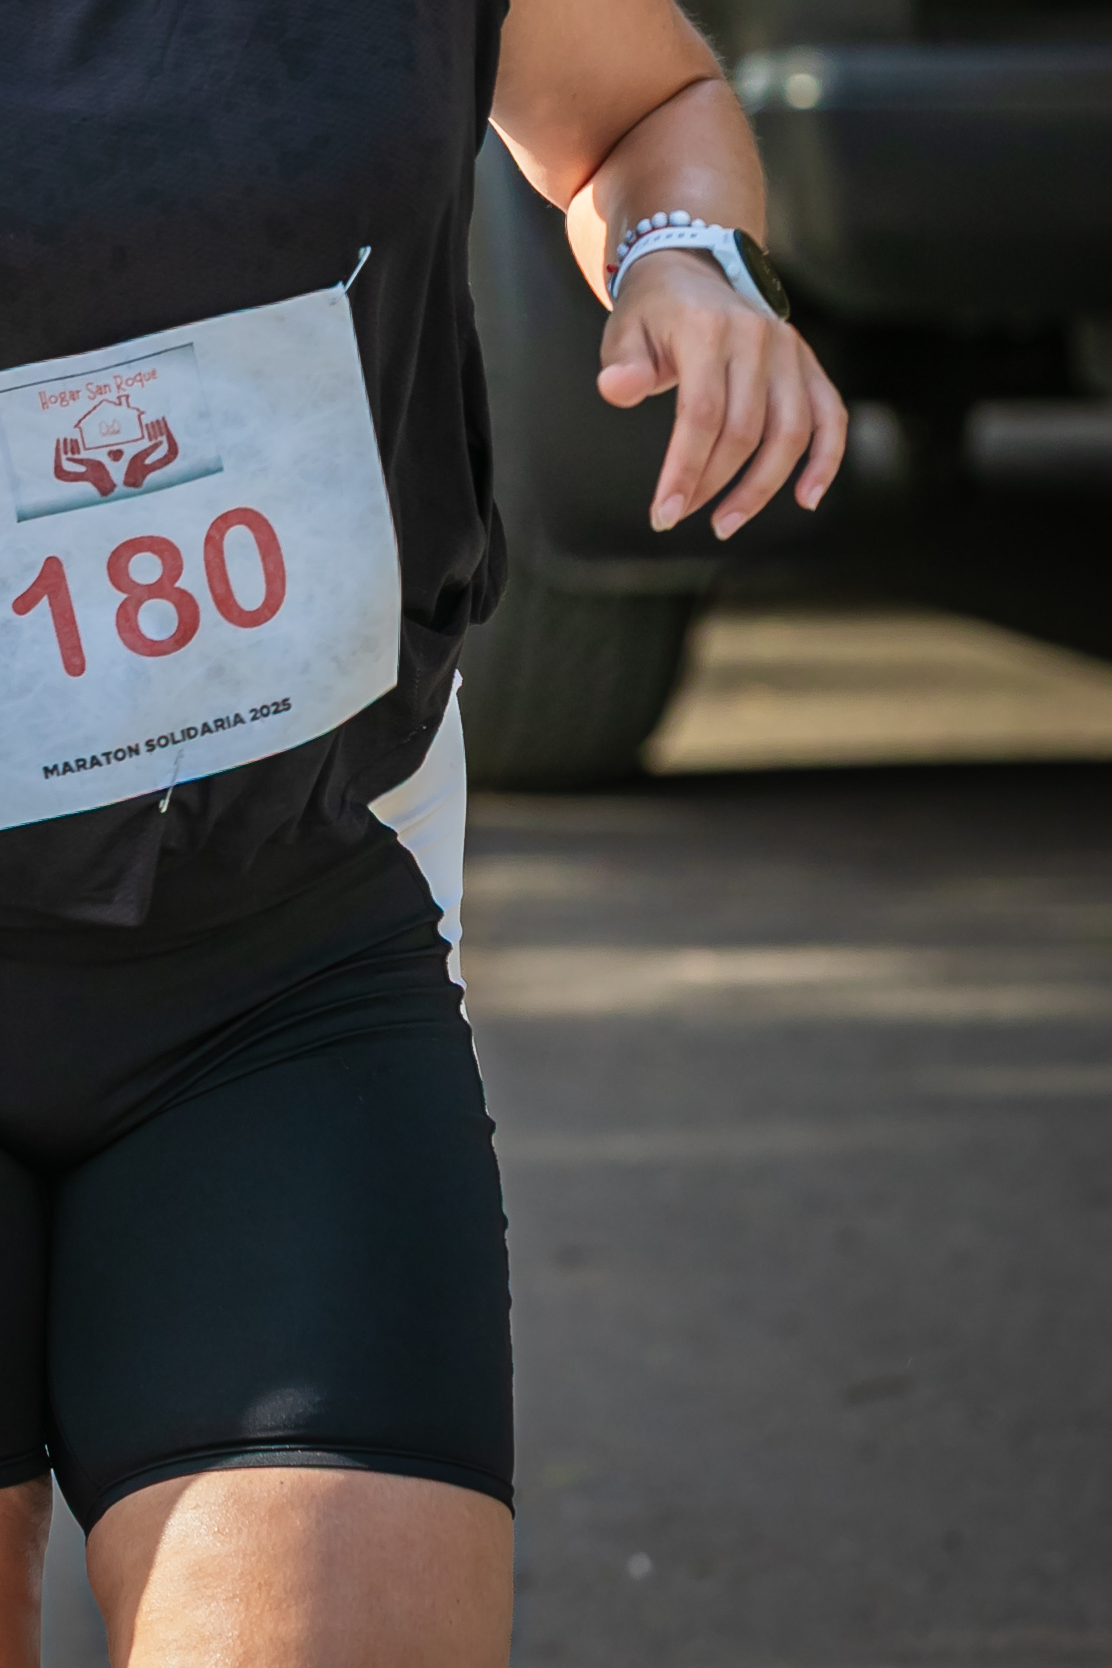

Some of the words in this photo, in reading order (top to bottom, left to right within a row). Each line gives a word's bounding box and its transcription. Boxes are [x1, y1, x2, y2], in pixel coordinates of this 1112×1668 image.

[38, 390, 80, 411] Hogar
[85, 381, 112, 401] San
[113, 368, 158, 394] Roque
[12, 507, 287, 677] 180
[42, 743, 141, 780] MARATON
[144, 712, 246, 753] SOLIDARIA
[249, 697, 293, 722] 2025
